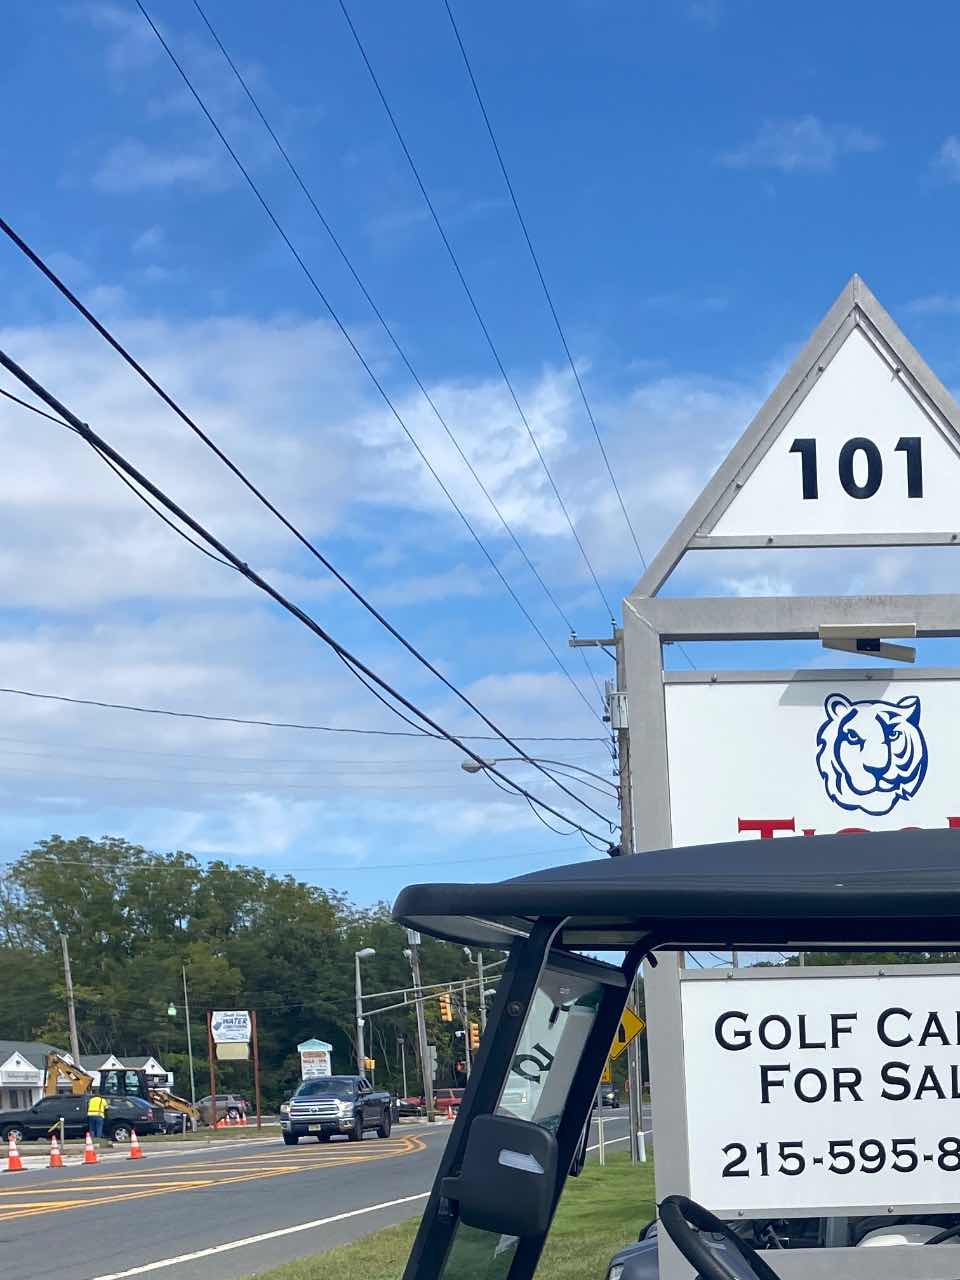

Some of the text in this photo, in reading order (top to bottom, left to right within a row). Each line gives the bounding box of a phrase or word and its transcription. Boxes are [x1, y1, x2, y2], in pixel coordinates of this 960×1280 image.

[788, 436, 924, 500] 101
[222, 1017, 248, 1025] WATER
[714, 1010, 858, 1051] GOLF
[759, 1062, 864, 1104] FOR
